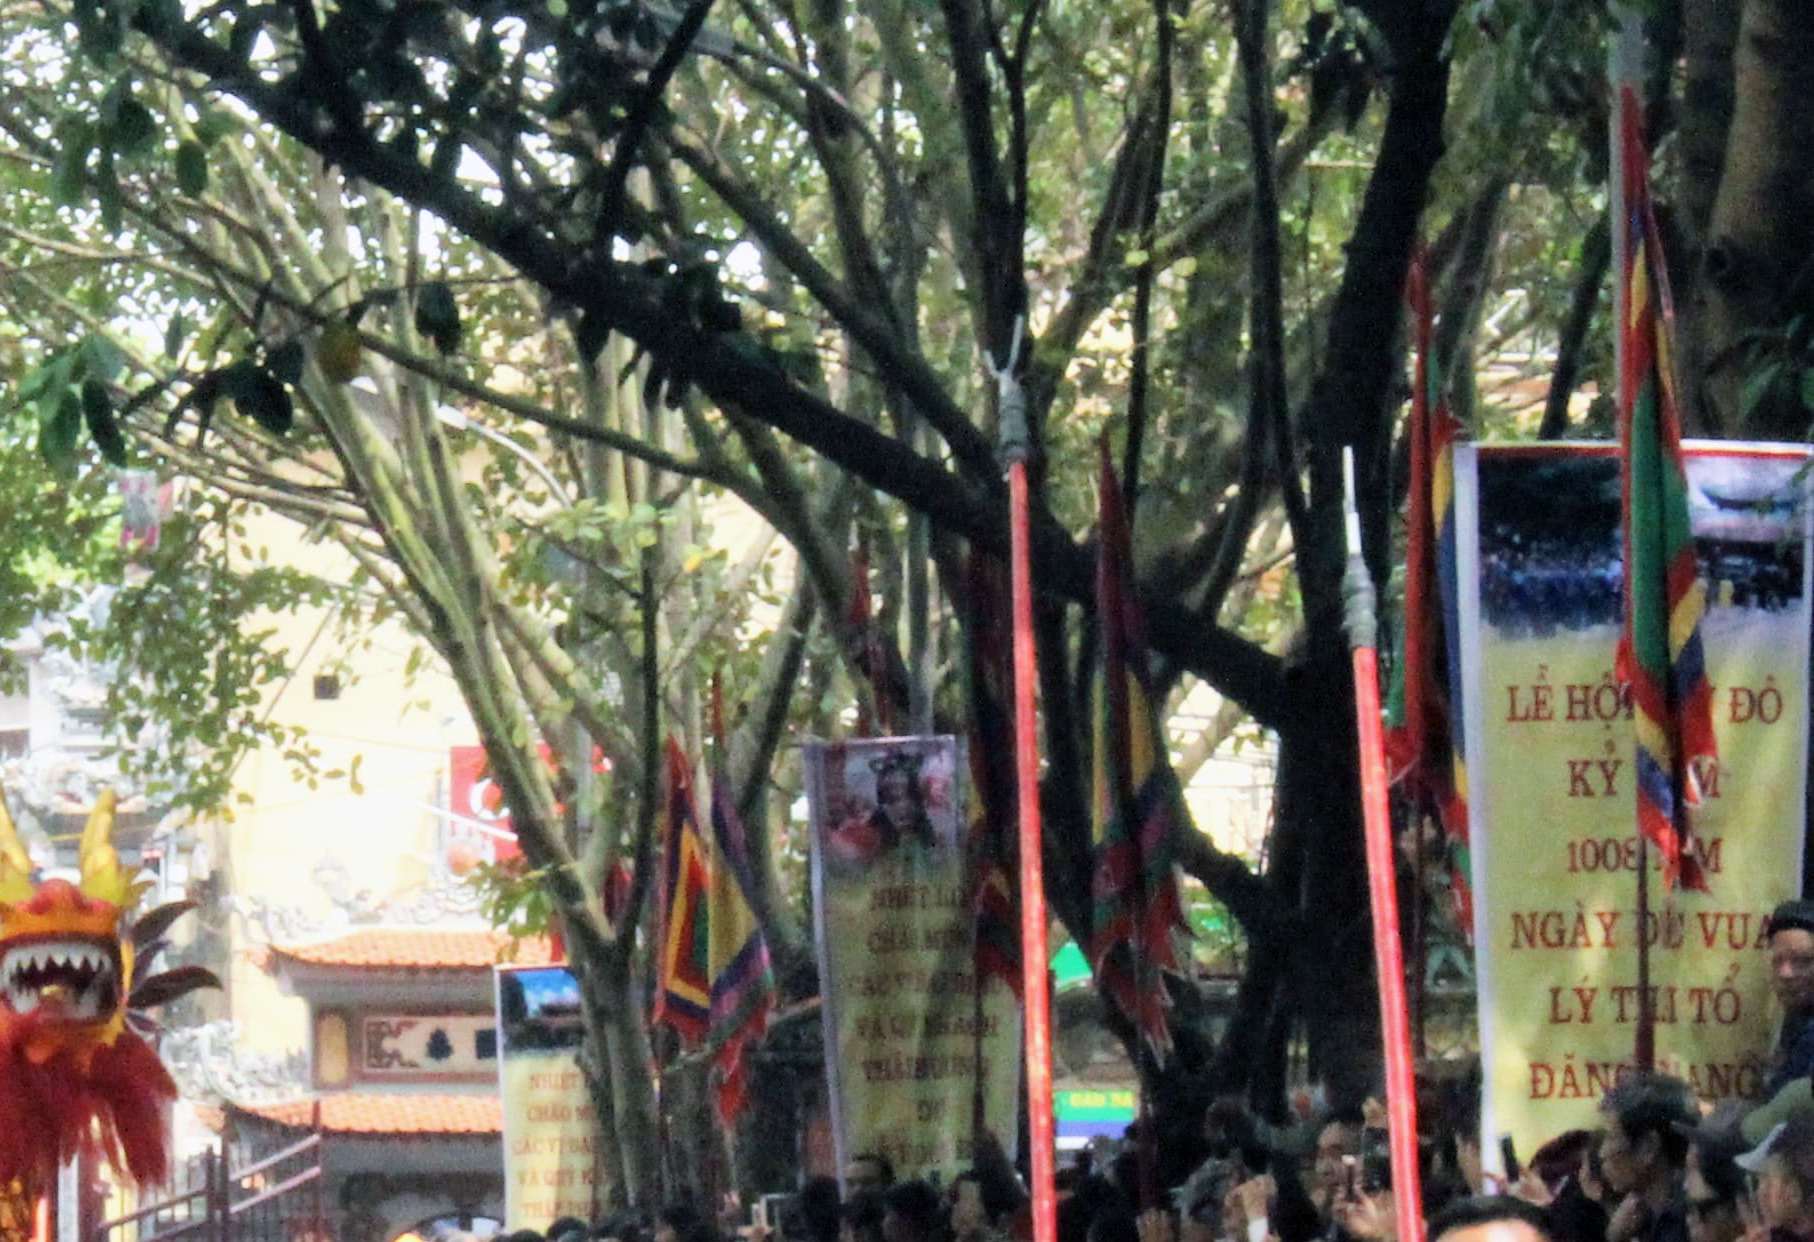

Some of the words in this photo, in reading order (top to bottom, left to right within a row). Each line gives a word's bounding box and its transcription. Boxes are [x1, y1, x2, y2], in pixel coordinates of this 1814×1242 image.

[1729, 674, 1784, 725] ĐÔ
[1510, 902, 1621, 950] NGÀY
[1548, 975, 1599, 1024] LÝ
[1689, 963, 1743, 1025] TỔ
